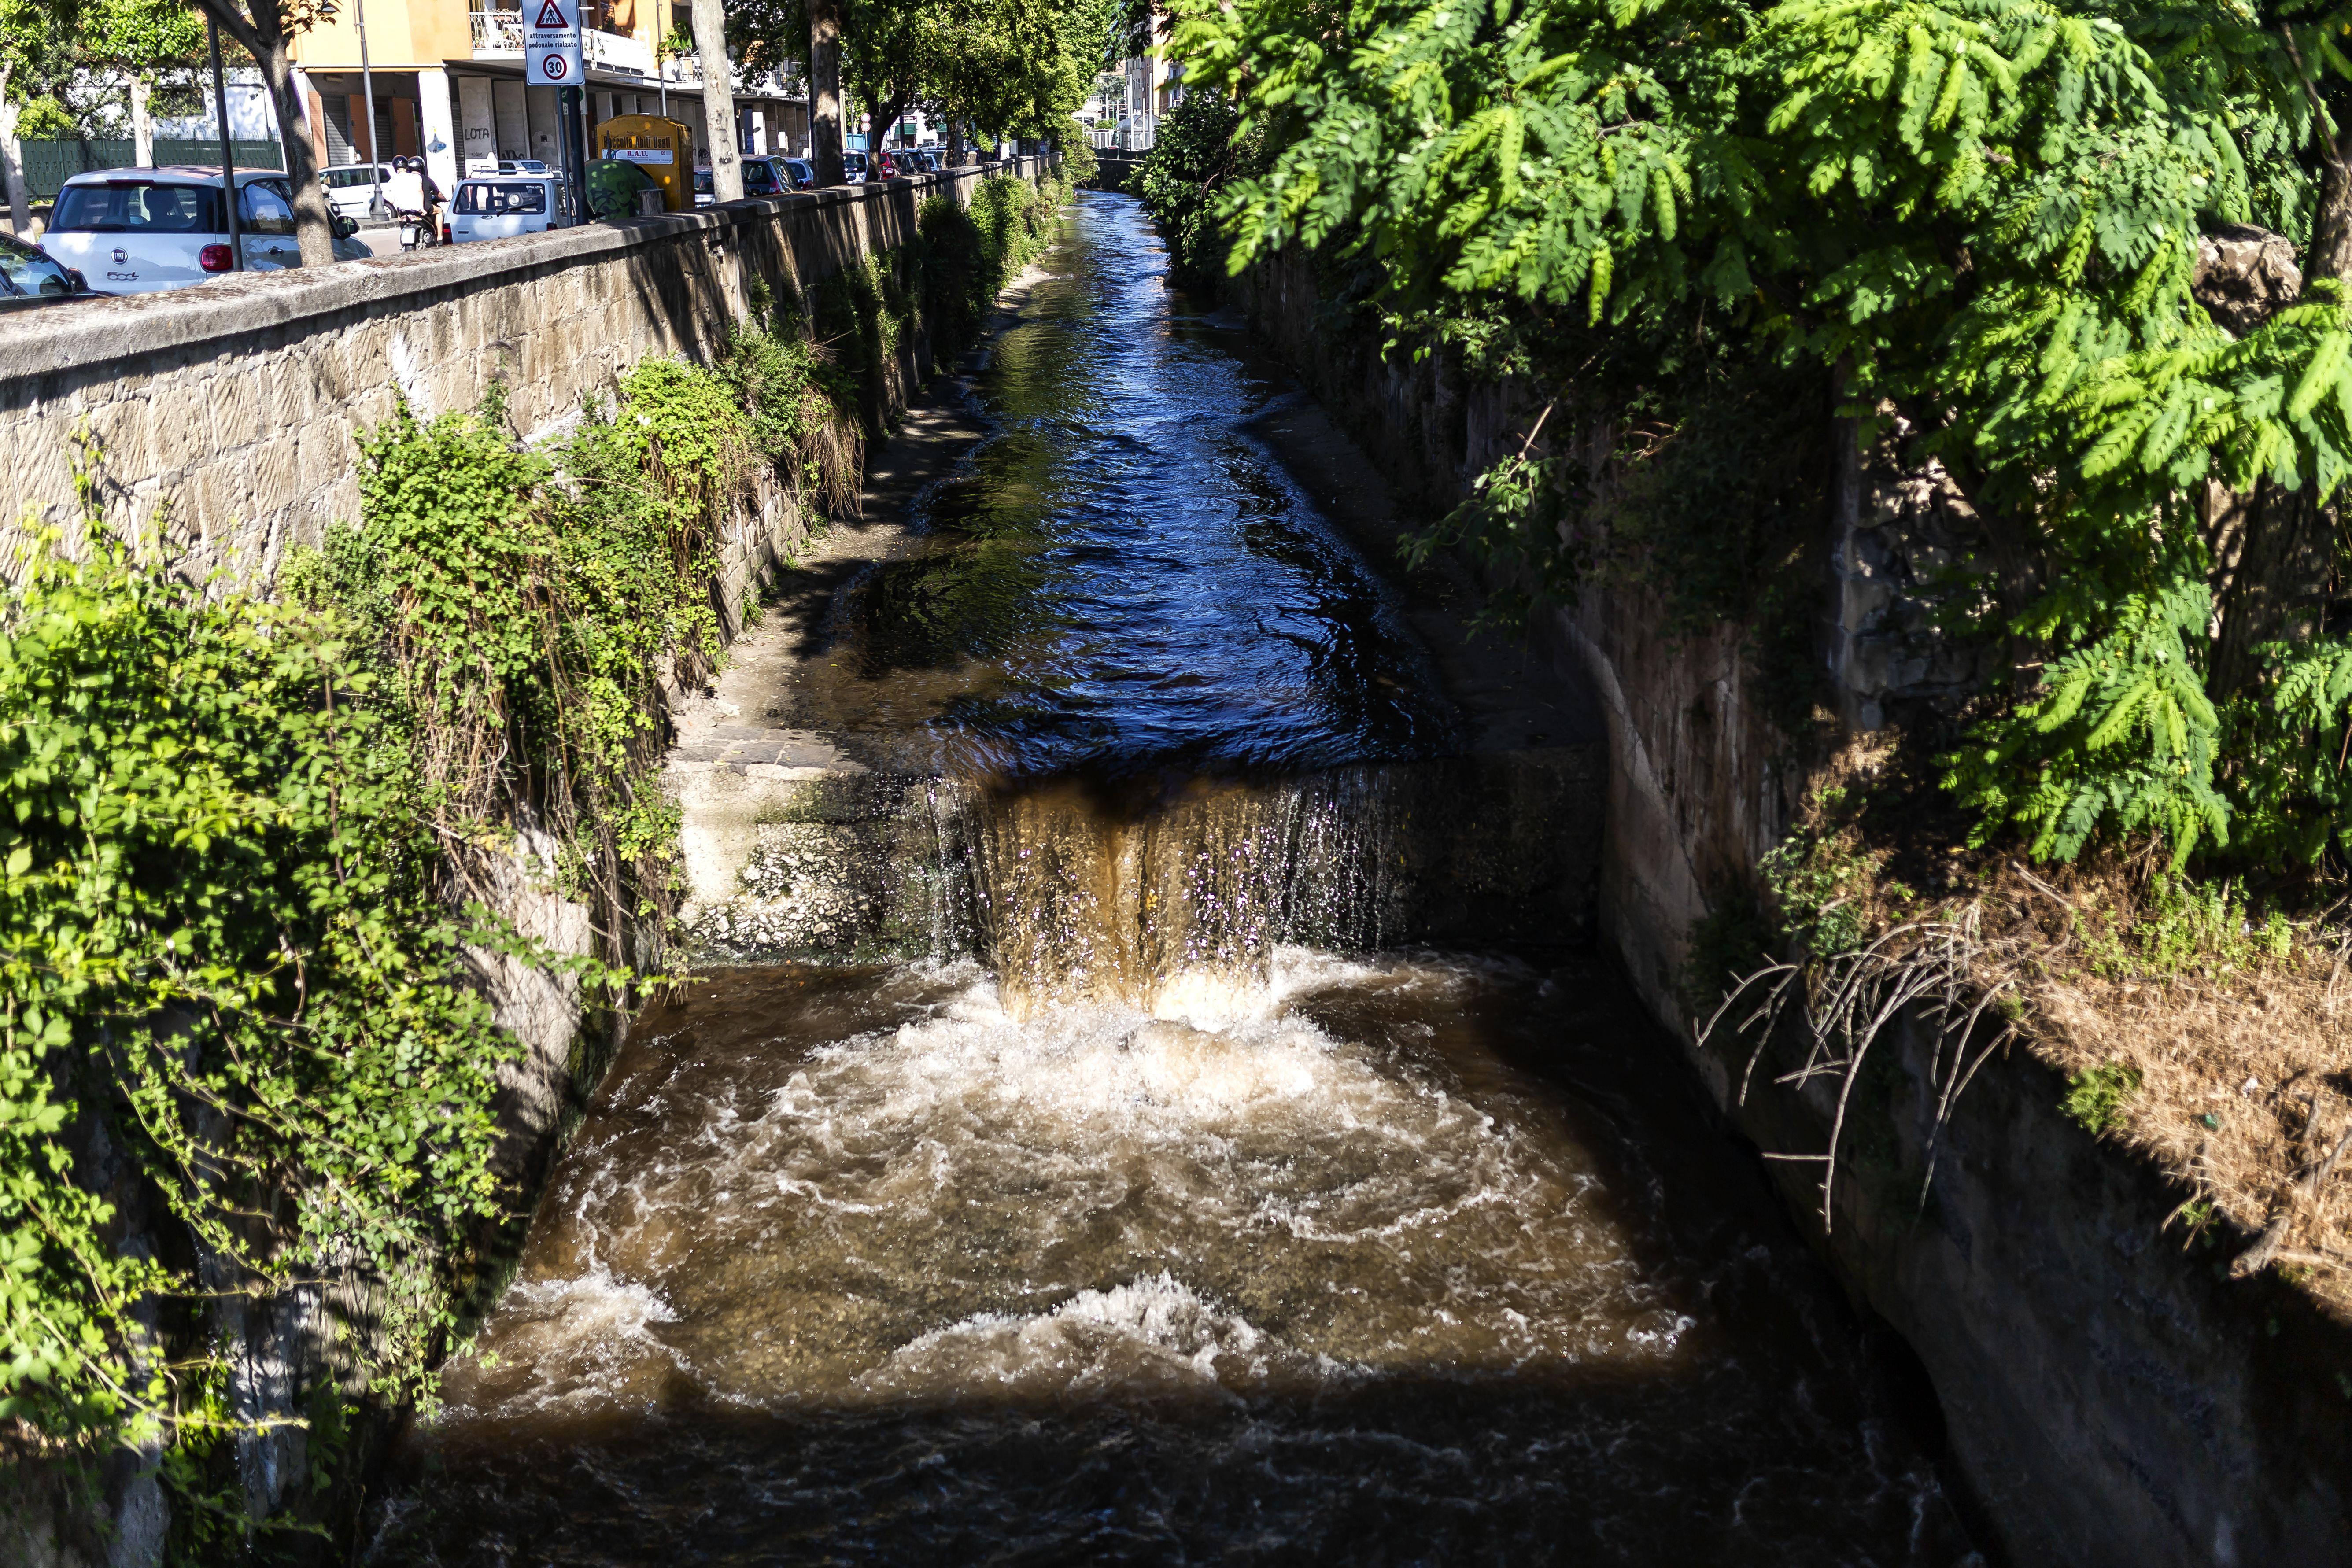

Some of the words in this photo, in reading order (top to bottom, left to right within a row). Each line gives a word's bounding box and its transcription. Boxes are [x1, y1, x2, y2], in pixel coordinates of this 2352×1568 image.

[548, 61, 562, 73] 30
[465, 128, 489, 140] LOTA
[635, 136, 650, 148] Abiti
[654, 137, 670, 148] Usati
